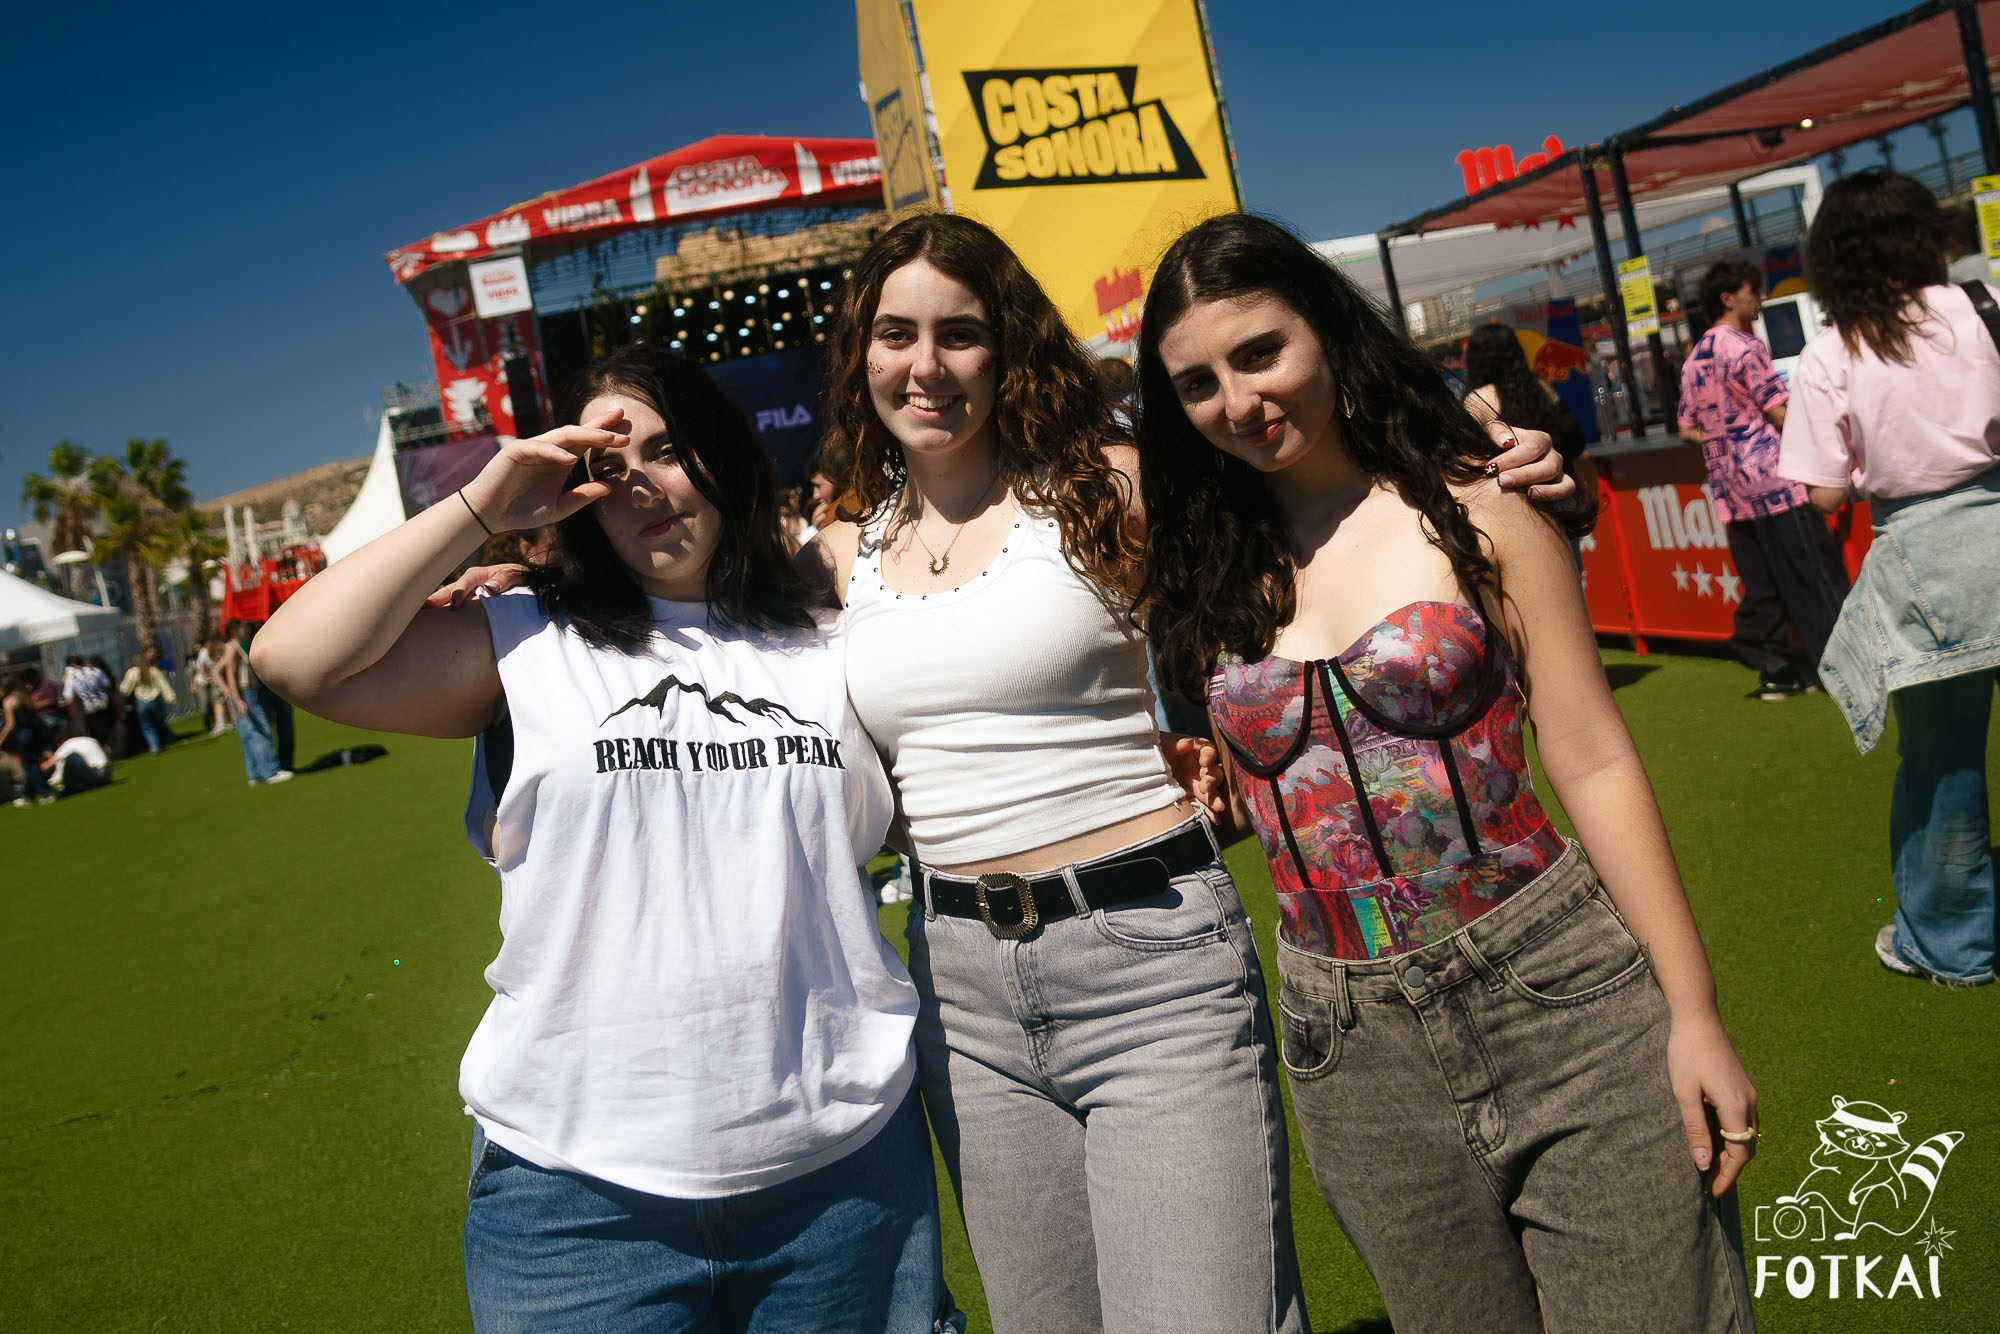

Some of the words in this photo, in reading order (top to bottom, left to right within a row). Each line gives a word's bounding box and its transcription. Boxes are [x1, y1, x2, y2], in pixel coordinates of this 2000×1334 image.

[982, 72, 1129, 146] COSTA
[994, 100, 1180, 181] SONORA
[755, 403, 812, 432] FILA
[593, 736, 680, 773] REACH
[686, 737, 768, 772] YOUR
[774, 735, 846, 769] PEAK
